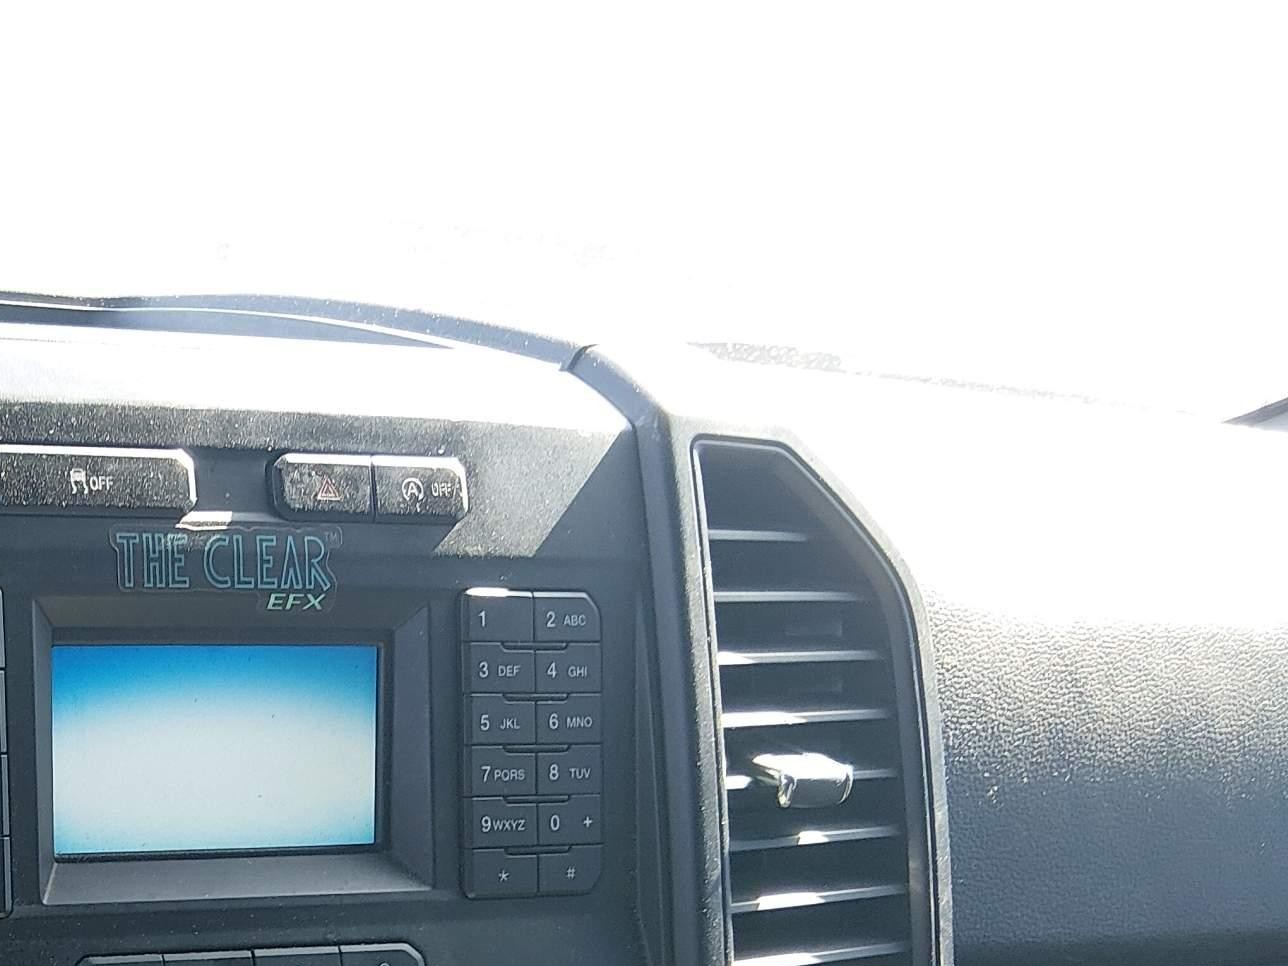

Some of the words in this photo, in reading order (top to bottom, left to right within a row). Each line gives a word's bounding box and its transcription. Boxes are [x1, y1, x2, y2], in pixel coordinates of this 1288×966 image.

[90, 476, 113, 490] OFF
[116, 533, 189, 588] THE
[203, 535, 331, 590] CLEAR
[266, 593, 326, 611] EFX
[478, 610, 486, 627] 1
[546, 611, 556, 628] 2
[563, 614, 587, 626] ABC
[479, 661, 489, 678] 3
[498, 665, 521, 677] DEF
[547, 662, 557, 678] 4
[568, 665, 588, 678] GHI
[480, 714, 490, 731] 5
[500, 718, 521, 730] JKL
[549, 713, 559, 730] 6
[566, 716, 593, 729] MNO
[481, 766, 491, 783] 7
[549, 764, 559, 781] 8
[569, 768, 592, 779] TUV
[481, 816, 491, 833] 9
[493, 819, 526, 831] WXYZ
[550, 815, 560, 831] 0
